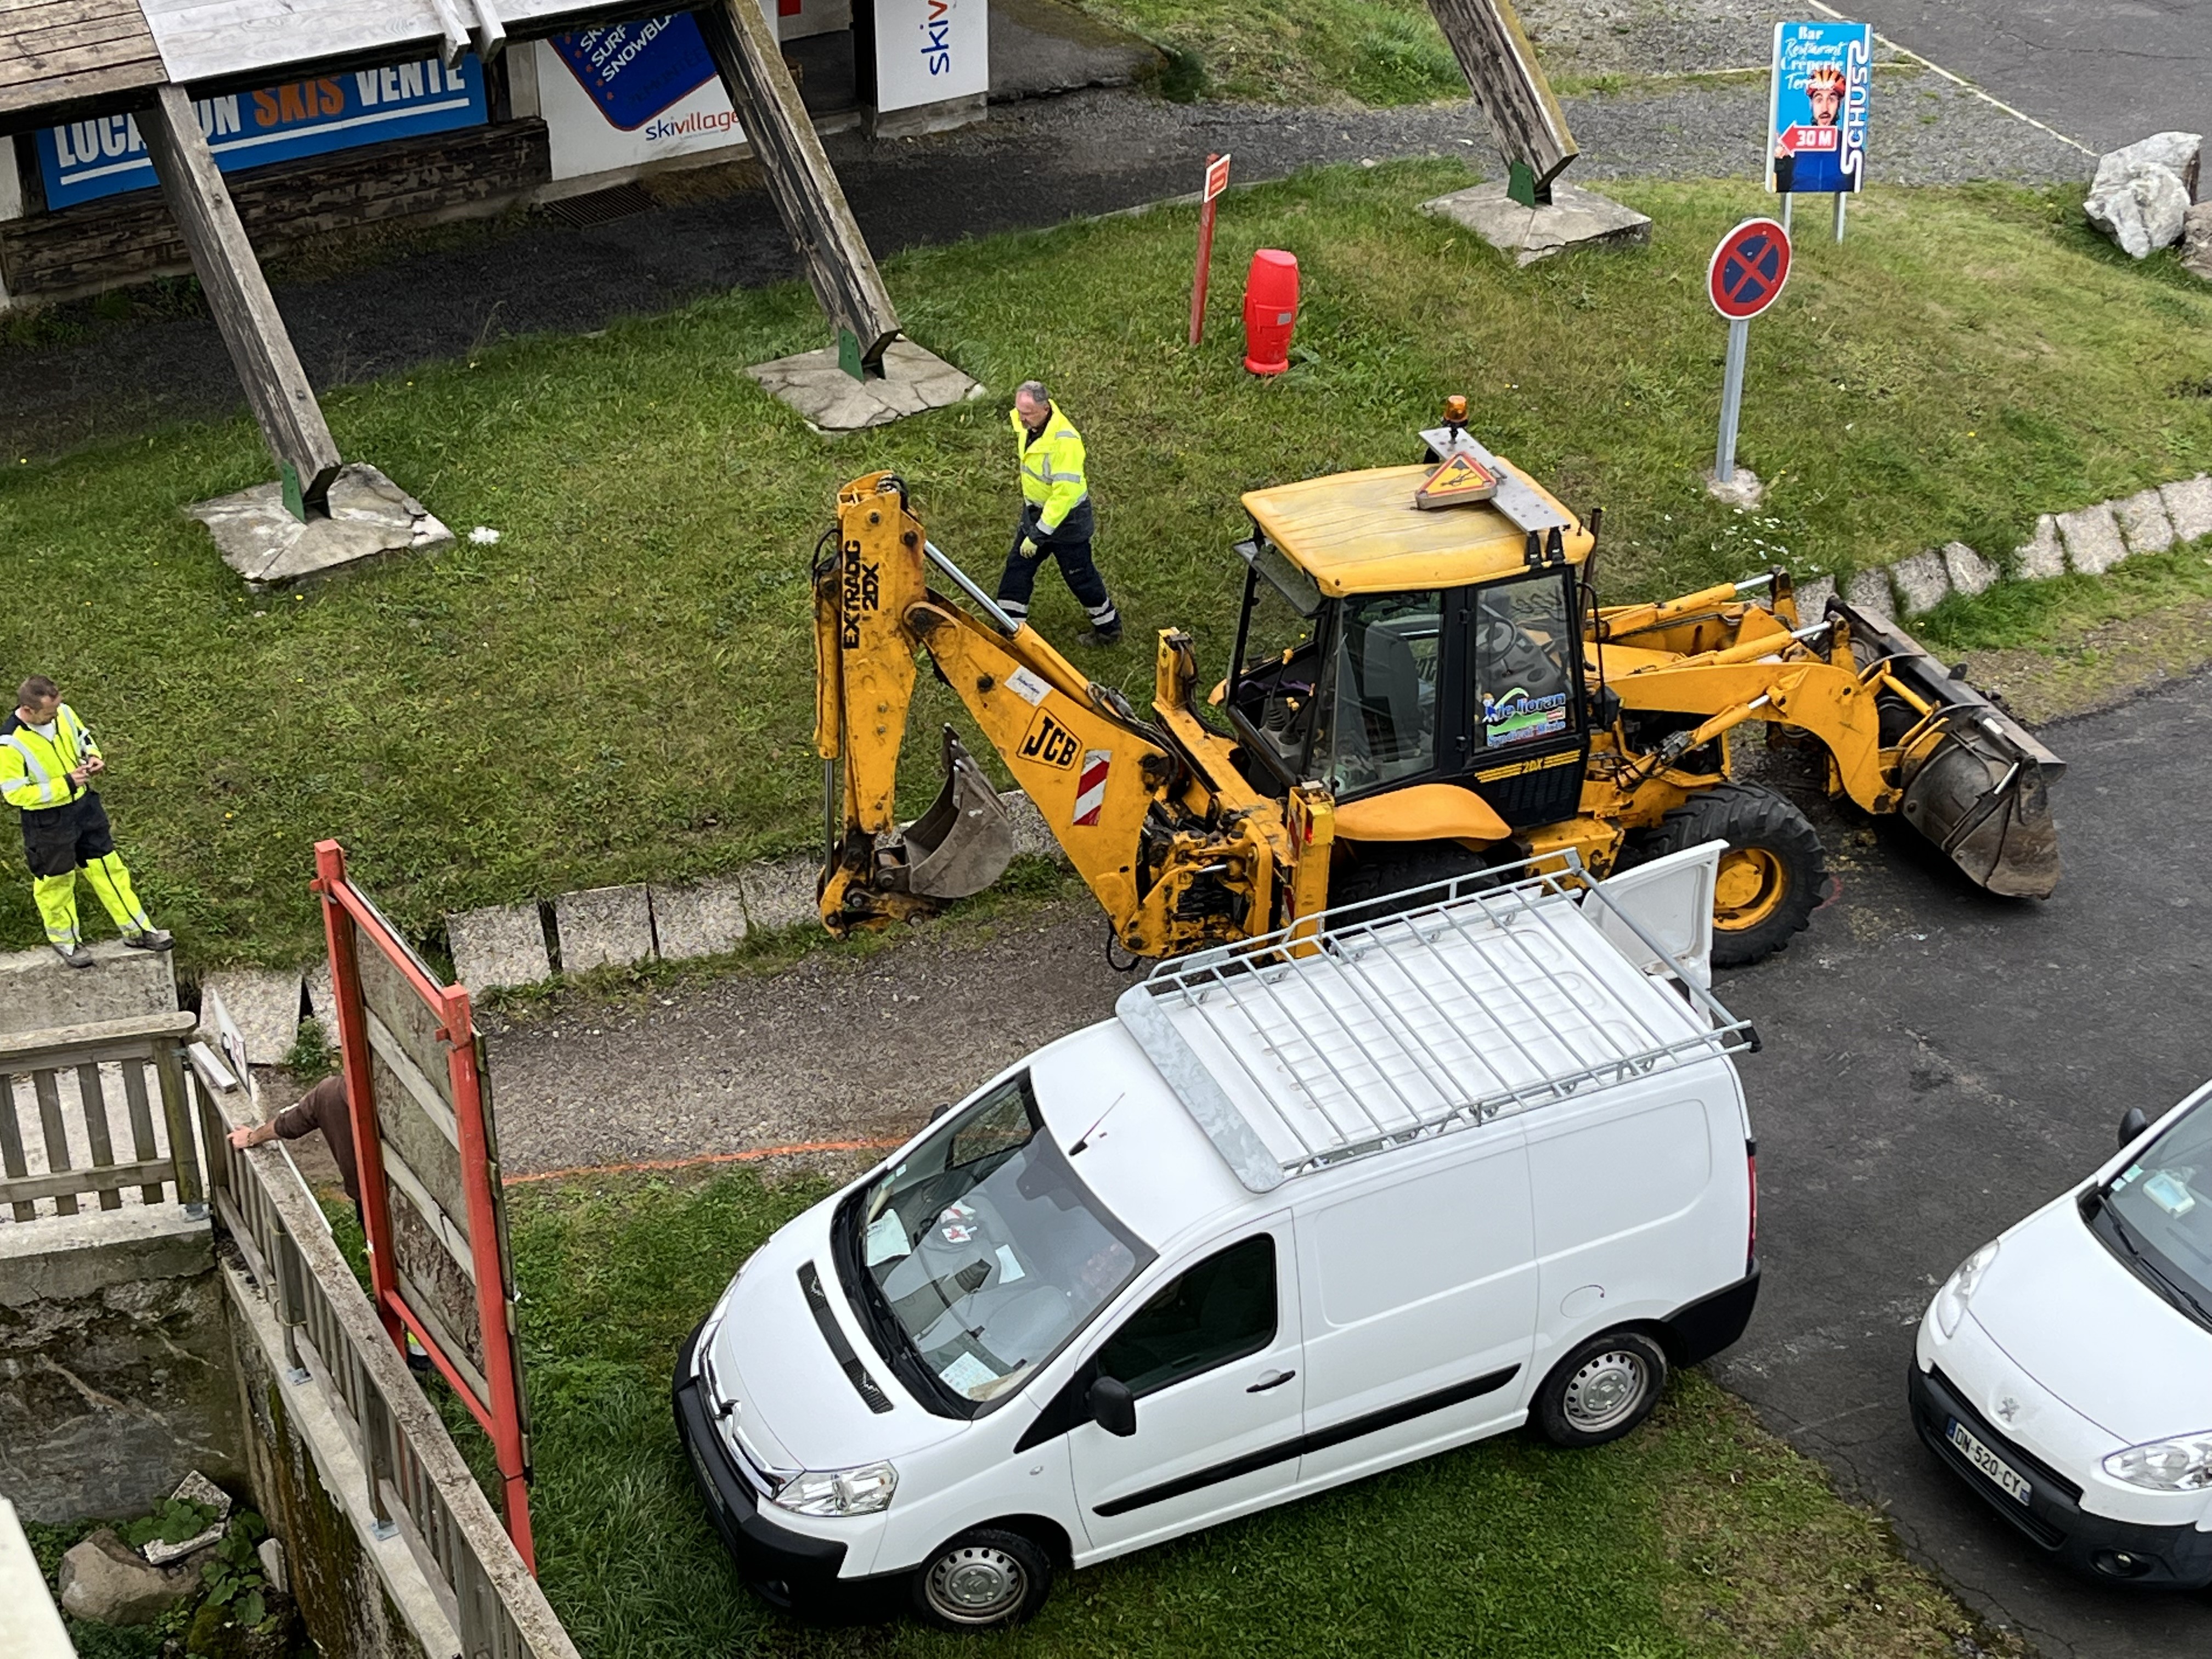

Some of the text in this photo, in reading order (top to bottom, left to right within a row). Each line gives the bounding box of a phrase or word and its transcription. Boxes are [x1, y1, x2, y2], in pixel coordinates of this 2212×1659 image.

[580, 27, 606, 53] SK
[591, 24, 627, 67] SURF
[1798, 25, 1824, 40] Bar
[53, 58, 466, 168] LOCAON SKIS VENTE
[645, 110, 740, 142] skivillage
[1796, 130, 1833, 146] 30 M
[861, 561, 879, 611] 2DX
[1022, 715, 1077, 766] JCB
